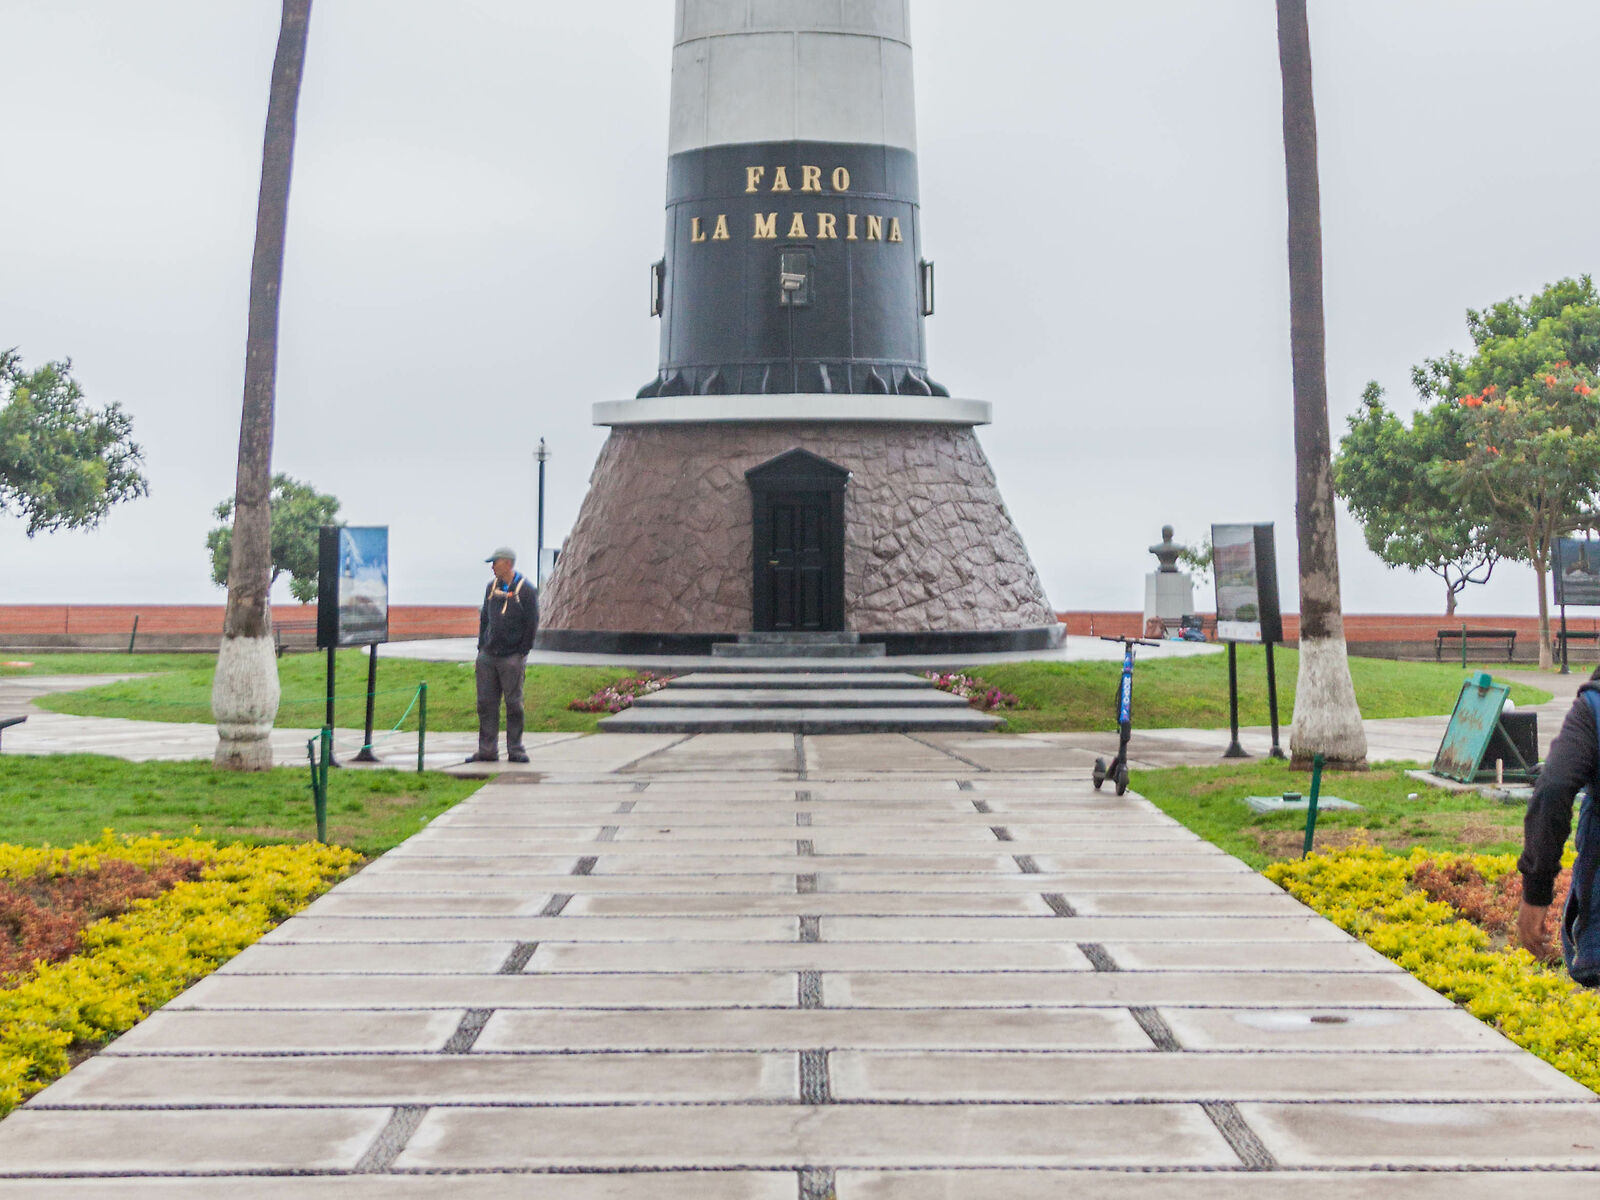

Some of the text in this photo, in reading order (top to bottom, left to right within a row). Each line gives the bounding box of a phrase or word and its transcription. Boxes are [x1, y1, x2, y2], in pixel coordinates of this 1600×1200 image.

[745, 165, 850, 192] FARO
[690, 212, 904, 243] LA MARINA
